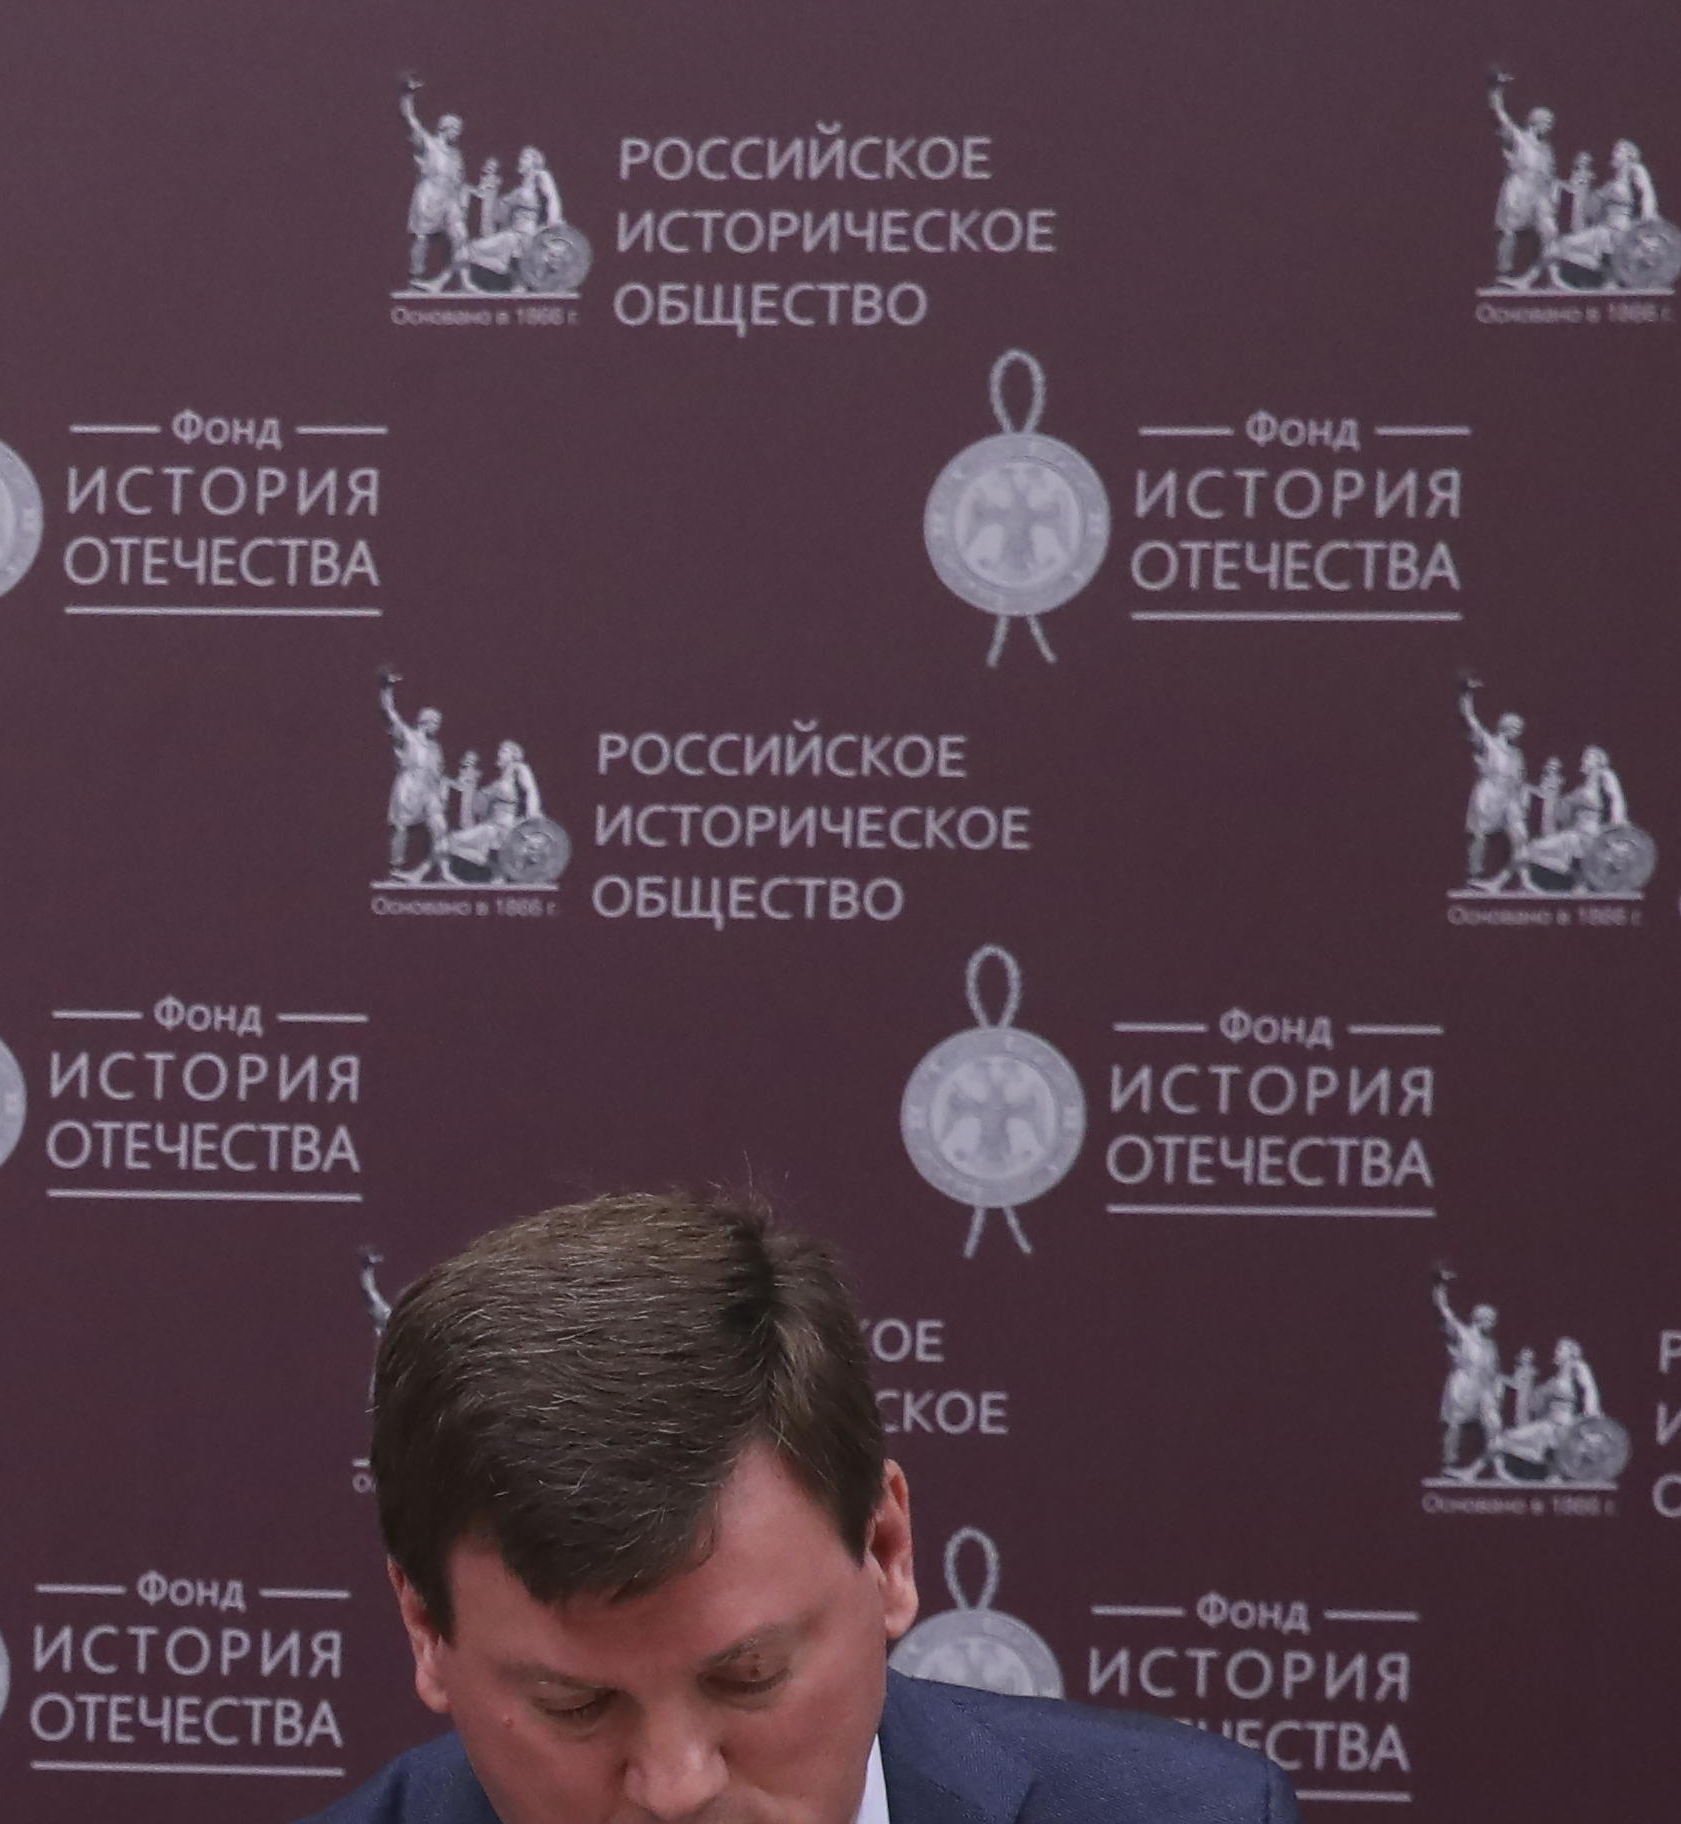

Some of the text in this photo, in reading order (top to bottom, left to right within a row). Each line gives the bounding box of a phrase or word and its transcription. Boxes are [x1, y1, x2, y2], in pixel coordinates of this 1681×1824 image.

[619, 121, 991, 181] РОССИЙСКОЕ
[617, 208, 1056, 254] ИСТОРИЧЕСКОЕ
[613, 281, 928, 338] ОБЩЕСТВО
[171, 408, 283, 450] Фонд
[1245, 410, 1360, 451] Фонд
[67, 465, 379, 516] ИСТОРИЯ
[1135, 468, 1461, 520] ИСТОРИЯ
[63, 535, 380, 587] ОТЕЧЕСТВА
[1130, 540, 1461, 591] ОТЕЧЕСТВА
[598, 719, 966, 778] РОССИЙСКОЕ
[595, 803, 1031, 851] ИСТОРИЧЕСКОЕ
[592, 874, 904, 931] ОБЩЕСТВО
[153, 995, 264, 1037] Фонд
[1219, 1007, 1334, 1049] Фонд
[49, 1051, 360, 1103] ИСТОРИЯ
[1110, 1063, 1434, 1116] ИСТОРИЯ
[46, 1119, 361, 1172] ОТЕЧЕСТВА
[1106, 1134, 1434, 1187] ОТЕЧЕСТВА
[136, 1570, 246, 1612] Фонд
[1196, 1591, 1310, 1634] Фонд
[33, 1624, 342, 1678] ИСТОРИЯ
[1089, 1647, 1410, 1701] ИСТОРИЯ
[29, 1692, 343, 1747] ОТЕЧЕСТВА
[1177, 1719, 1413, 1774] ЕСТВА
